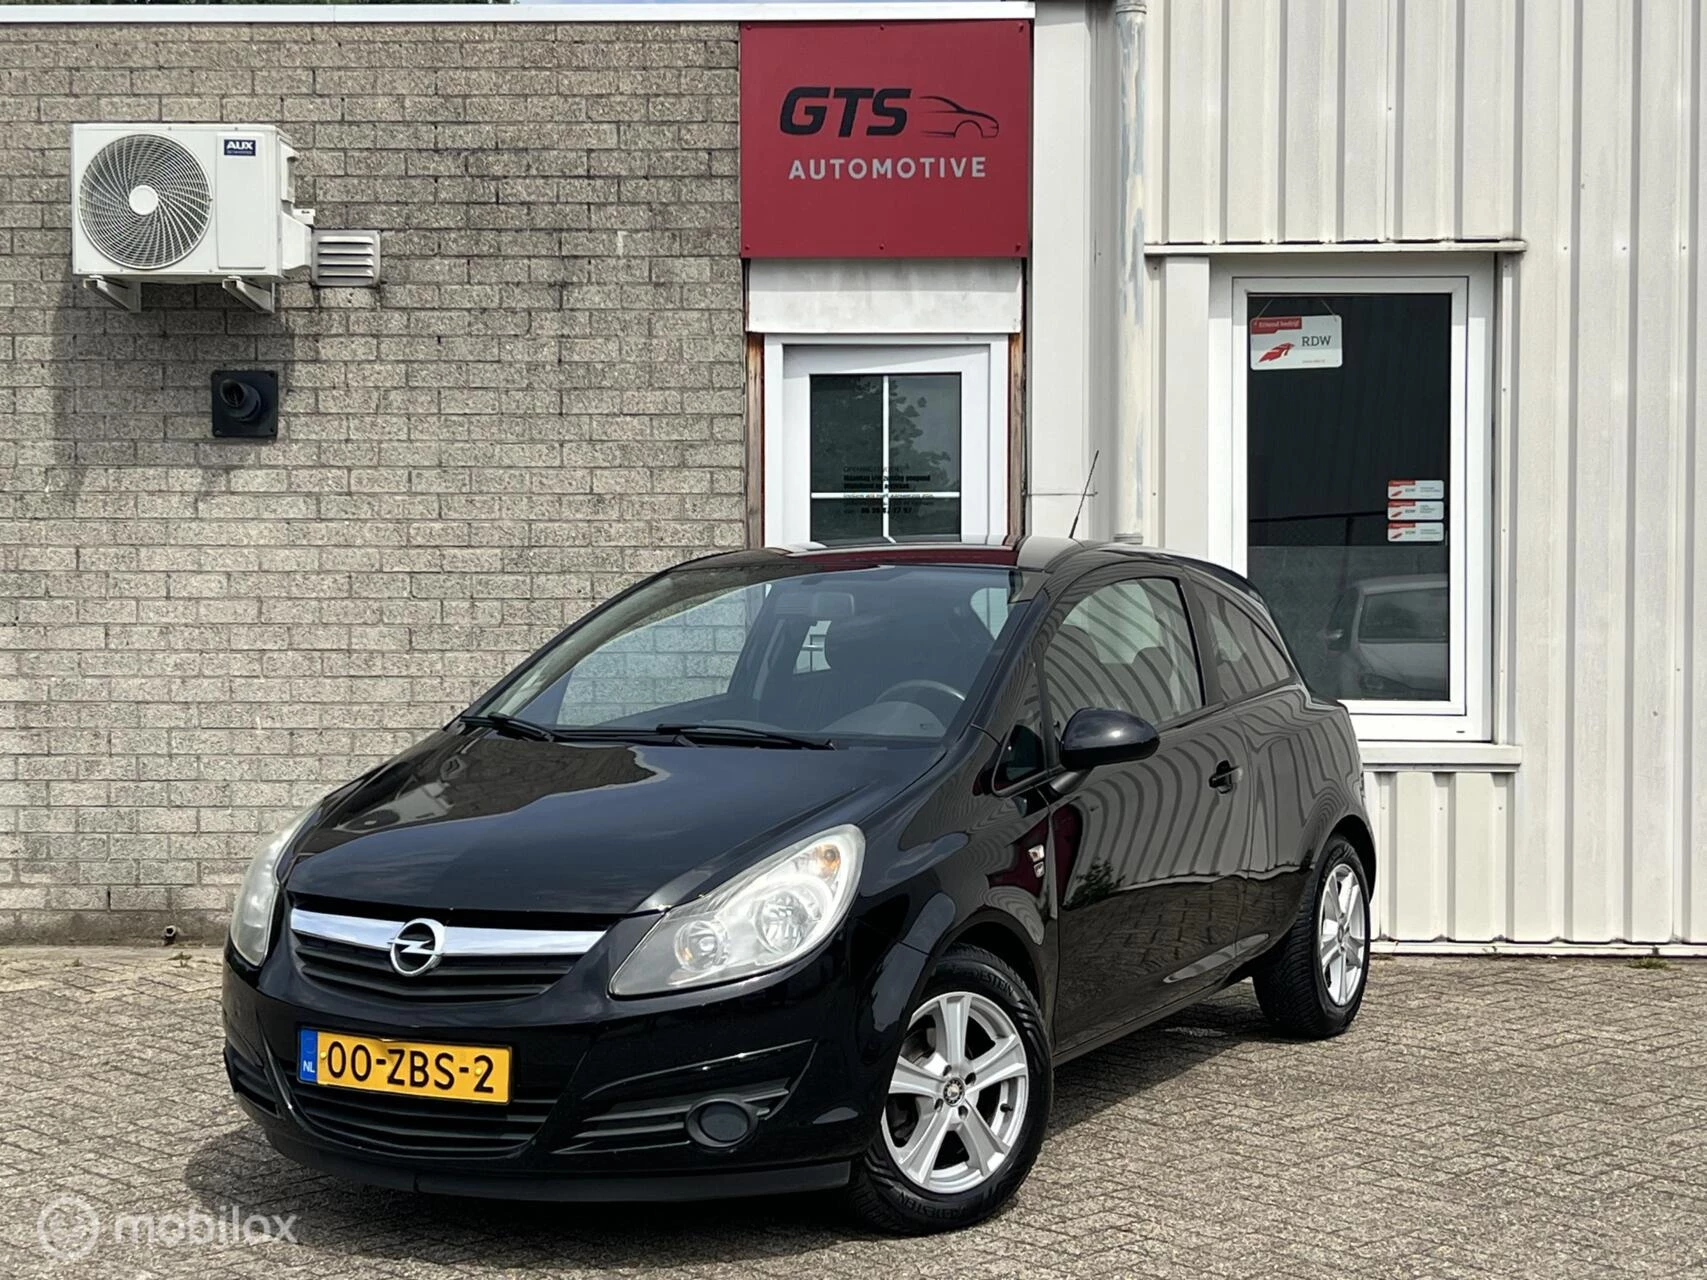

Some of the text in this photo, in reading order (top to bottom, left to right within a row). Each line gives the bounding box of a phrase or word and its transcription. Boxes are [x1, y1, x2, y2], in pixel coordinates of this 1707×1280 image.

[780, 86, 912, 137] GTS
[227, 141, 253, 150] AUX
[788, 157, 986, 180] AUTOMOTIVE
[1301, 335, 1331, 347] RDW
[303, 1060, 316, 1073] NL
[327, 1041, 494, 1093] 00-ZBS-2
